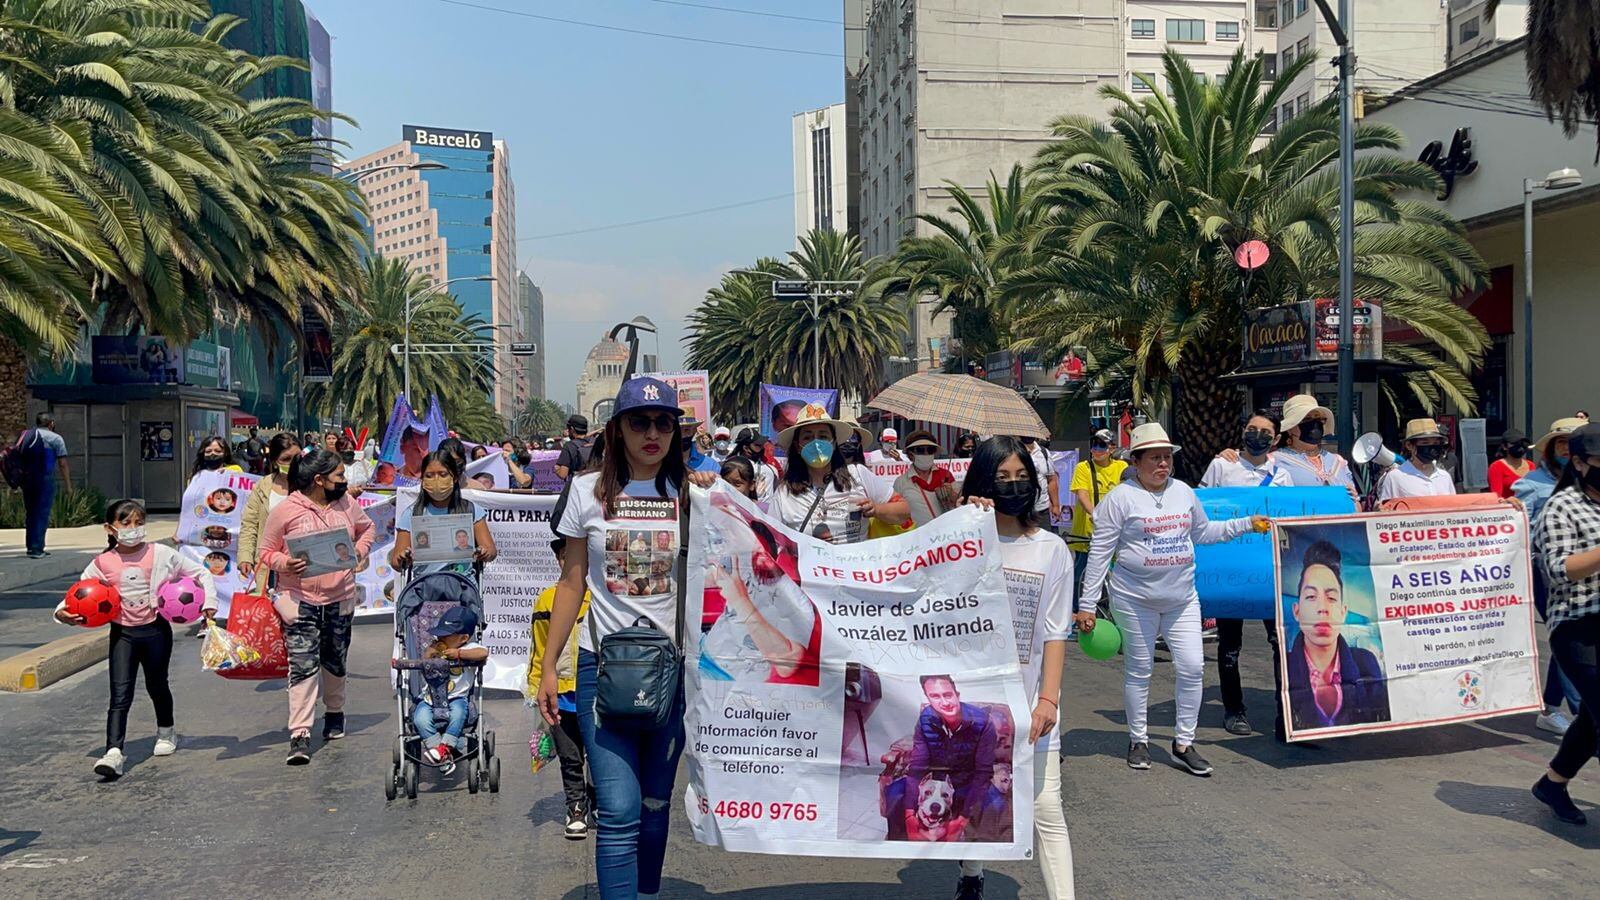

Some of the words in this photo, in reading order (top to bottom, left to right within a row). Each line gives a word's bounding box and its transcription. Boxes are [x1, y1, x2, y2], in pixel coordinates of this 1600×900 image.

[415, 130, 482, 149] Barceló
[1249, 322, 1307, 353] Oaxaca
[620, 501, 674, 509] BUSCAMOS
[519, 510, 551, 522] PARA
[617, 510, 667, 518] HERMANO
[1155, 514, 1181, 523] quiero
[1144, 524, 1178, 534] Regreso
[1376, 522, 1398, 532] Diego
[1399, 519, 1445, 530] Maximiliano
[1447, 518, 1469, 527] Rosas
[1379, 524, 1515, 544] SECUESTRADO
[1399, 543, 1437, 554] Ecatepec,
[1438, 541, 1466, 551] Estado
[1467, 541, 1477, 549] de
[1478, 536, 1510, 548] México
[813, 565, 845, 580] ¡TE
[852, 540, 984, 584] BUSCAMOS!
[1404, 555, 1409, 563] 4
[1410, 554, 1420, 563] de
[1422, 551, 1466, 563] septiembre
[1467, 550, 1478, 558] de
[1479, 547, 1504, 557] 2015.
[1391, 574, 1404, 590] A
[1409, 570, 1452, 589] SEIS
[1459, 564, 1511, 584] AÑOS
[513, 586, 523, 595] LA
[524, 586, 540, 595] VOZ
[1390, 591, 1414, 602] Diego
[1416, 587, 1457, 599] continúa
[1460, 581, 1515, 595] desaparecido
[827, 600, 884, 618] Javier
[890, 600, 915, 617] de
[920, 592, 979, 615] Jesús
[1385, 601, 1455, 620] EXIGIMOS
[1460, 594, 1523, 612] JUSTICIA:
[498, 614, 530, 623] ESTABAS
[1402, 613, 1466, 628] Presentación
[1485, 610, 1500, 619] vida
[1501, 610, 1506, 618] y
[489, 630, 496, 639] A
[497, 630, 511, 639] LOS
[513, 630, 518, 638] 5
[838, 625, 907, 642] onzález
[912, 616, 994, 641] Miranda
[1407, 626, 1441, 638] castigo
[1444, 626, 1451, 634] a
[1453, 623, 1468, 633] los
[1470, 619, 1505, 632] culpables
[512, 646, 528, 655] POR
[1424, 642, 1433, 652] Ni
[1435, 639, 1467, 653] perdón,
[1468, 639, 1476, 648] ni
[1396, 661, 1416, 673] Hasta
[724, 707, 791, 723] Cualquier
[697, 722, 777, 739] información
[782, 727, 818, 741] favor
[695, 740, 709, 753] de
[712, 744, 803, 758] comunicarse
[806, 747, 818, 758] al
[723, 761, 785, 775] teléfono:
[714, 801, 763, 819] 4680
[769, 803, 818, 821] 9765
